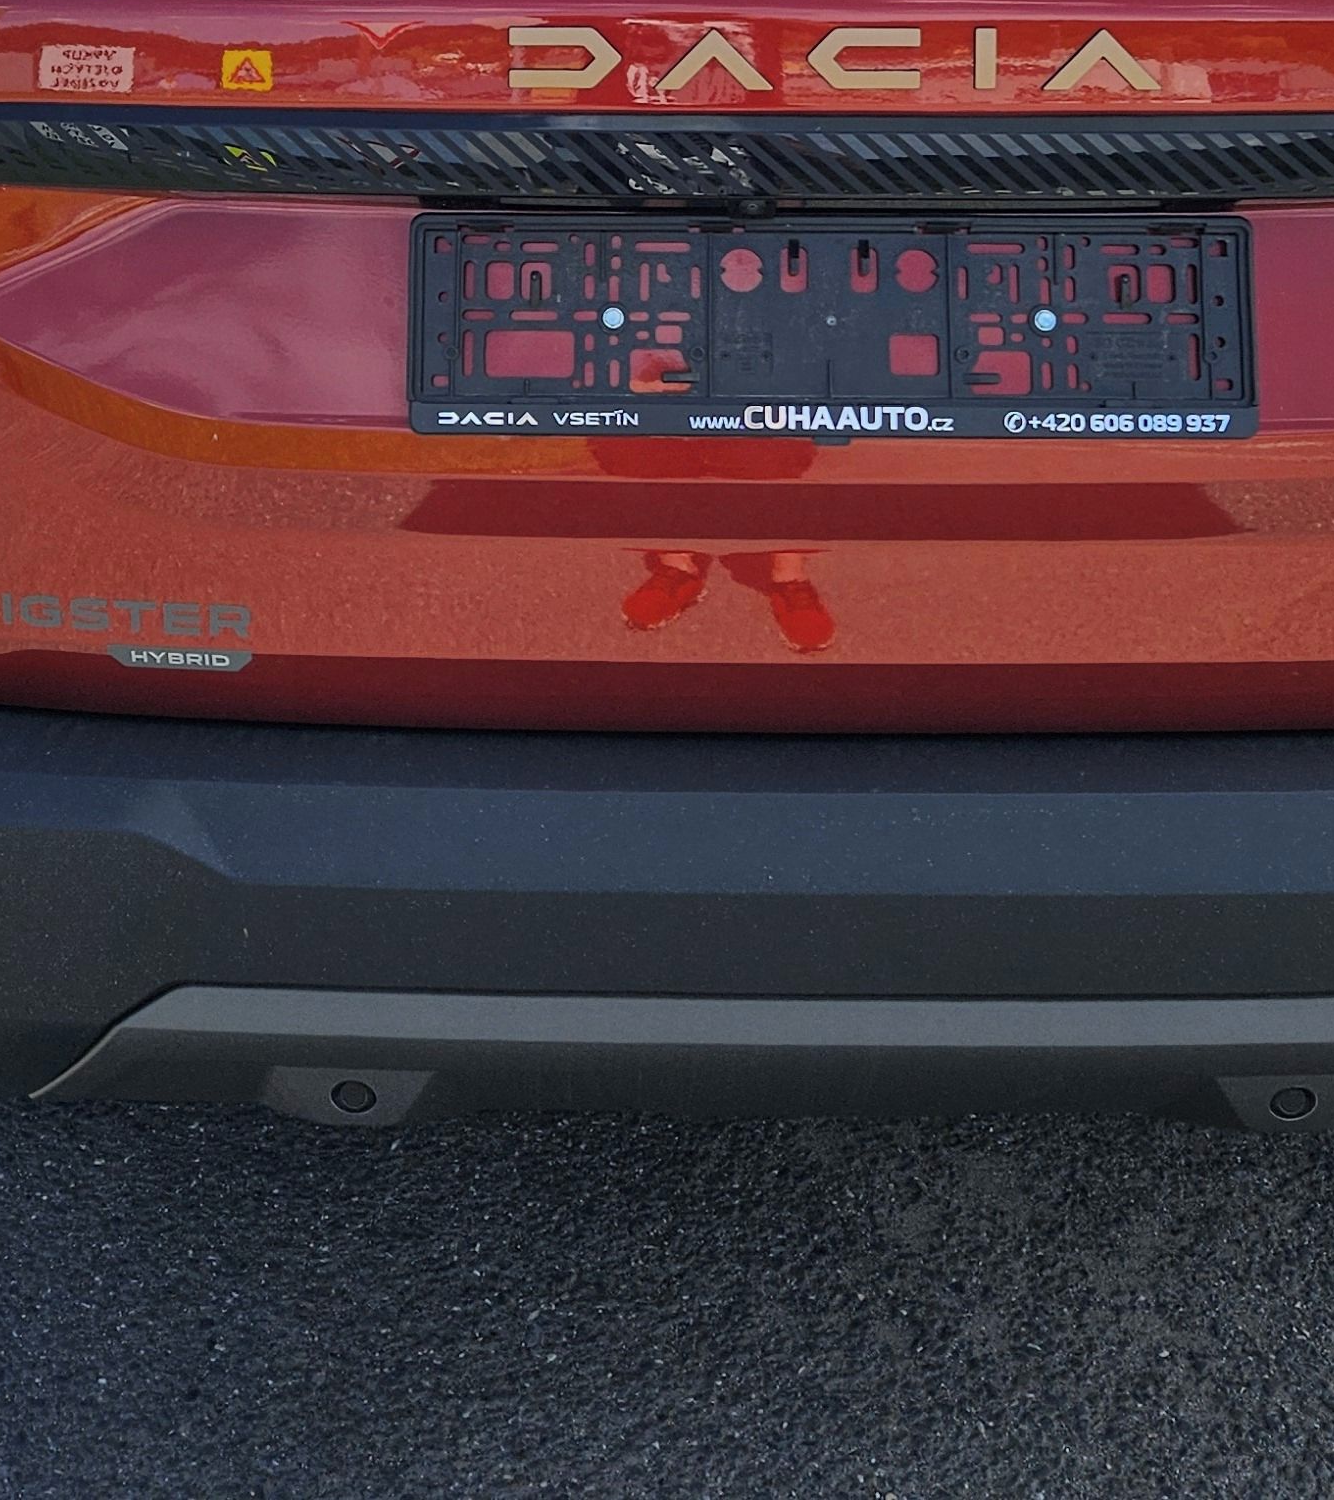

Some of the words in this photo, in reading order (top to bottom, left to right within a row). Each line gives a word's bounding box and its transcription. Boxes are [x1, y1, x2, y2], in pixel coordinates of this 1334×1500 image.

[508, 25, 1161, 91] DACIA
[438, 411, 538, 426] DACIA
[553, 408, 639, 426] VSETÍN
[689, 405, 954, 432] www.CUHAAUTO.cz
[1028, 414, 1085, 433] +420
[1089, 414, 1134, 433] 606
[1138, 414, 1182, 433] 089
[1186, 414, 1230, 433] 937
[130, 649, 230, 668] HYBRID
